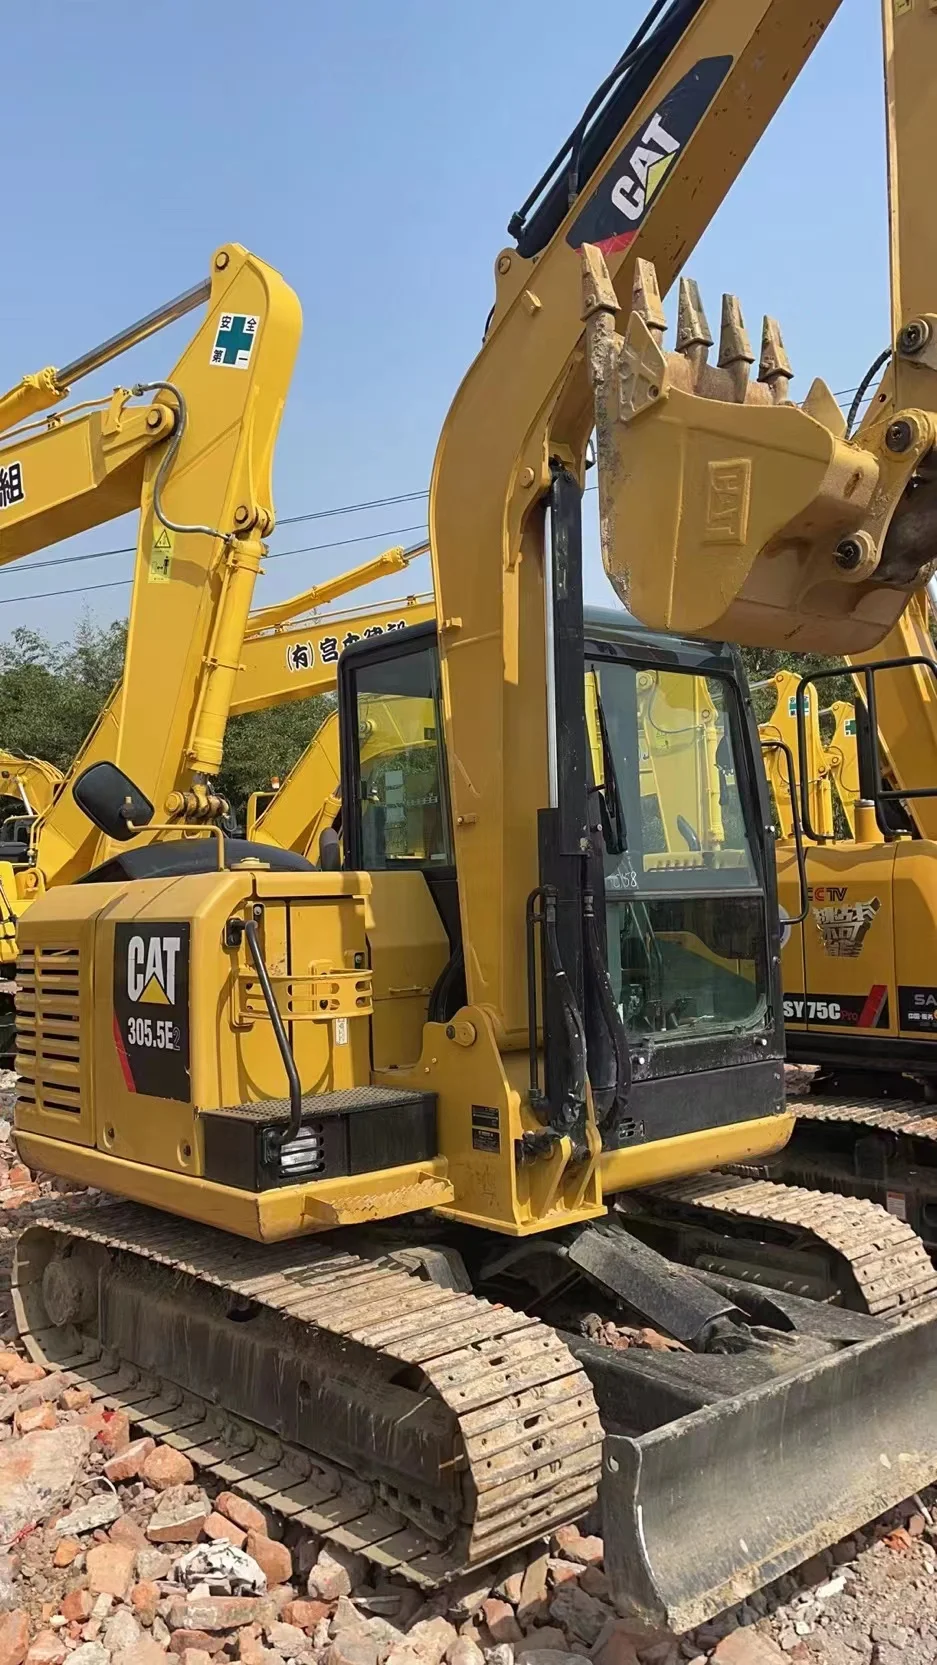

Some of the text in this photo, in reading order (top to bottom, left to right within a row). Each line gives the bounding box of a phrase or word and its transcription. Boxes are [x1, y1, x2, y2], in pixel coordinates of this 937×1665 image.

[611, 112, 680, 220] CAT
[220, 316, 257, 331] 安全
[212, 349, 248, 363] 第一
[128, 935, 181, 1005] CAT
